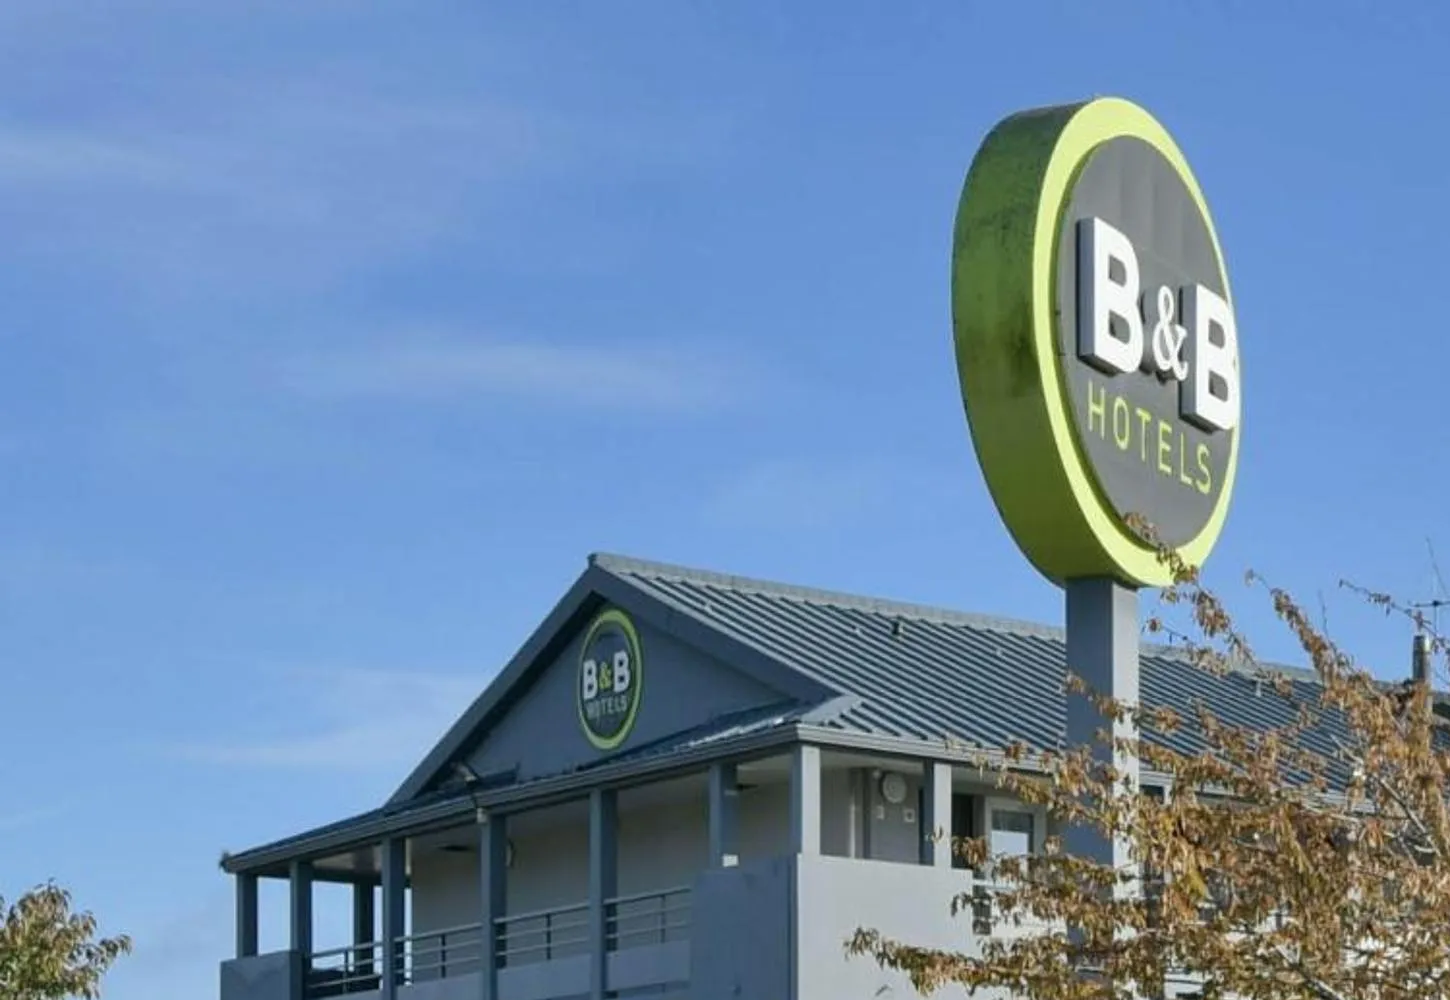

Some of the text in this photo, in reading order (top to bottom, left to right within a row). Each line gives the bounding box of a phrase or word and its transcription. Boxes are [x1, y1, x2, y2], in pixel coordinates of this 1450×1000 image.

[1078, 217, 1239, 432] B&B
[1086, 380, 1213, 495] HOTELS
[583, 650, 630, 701] B&B
